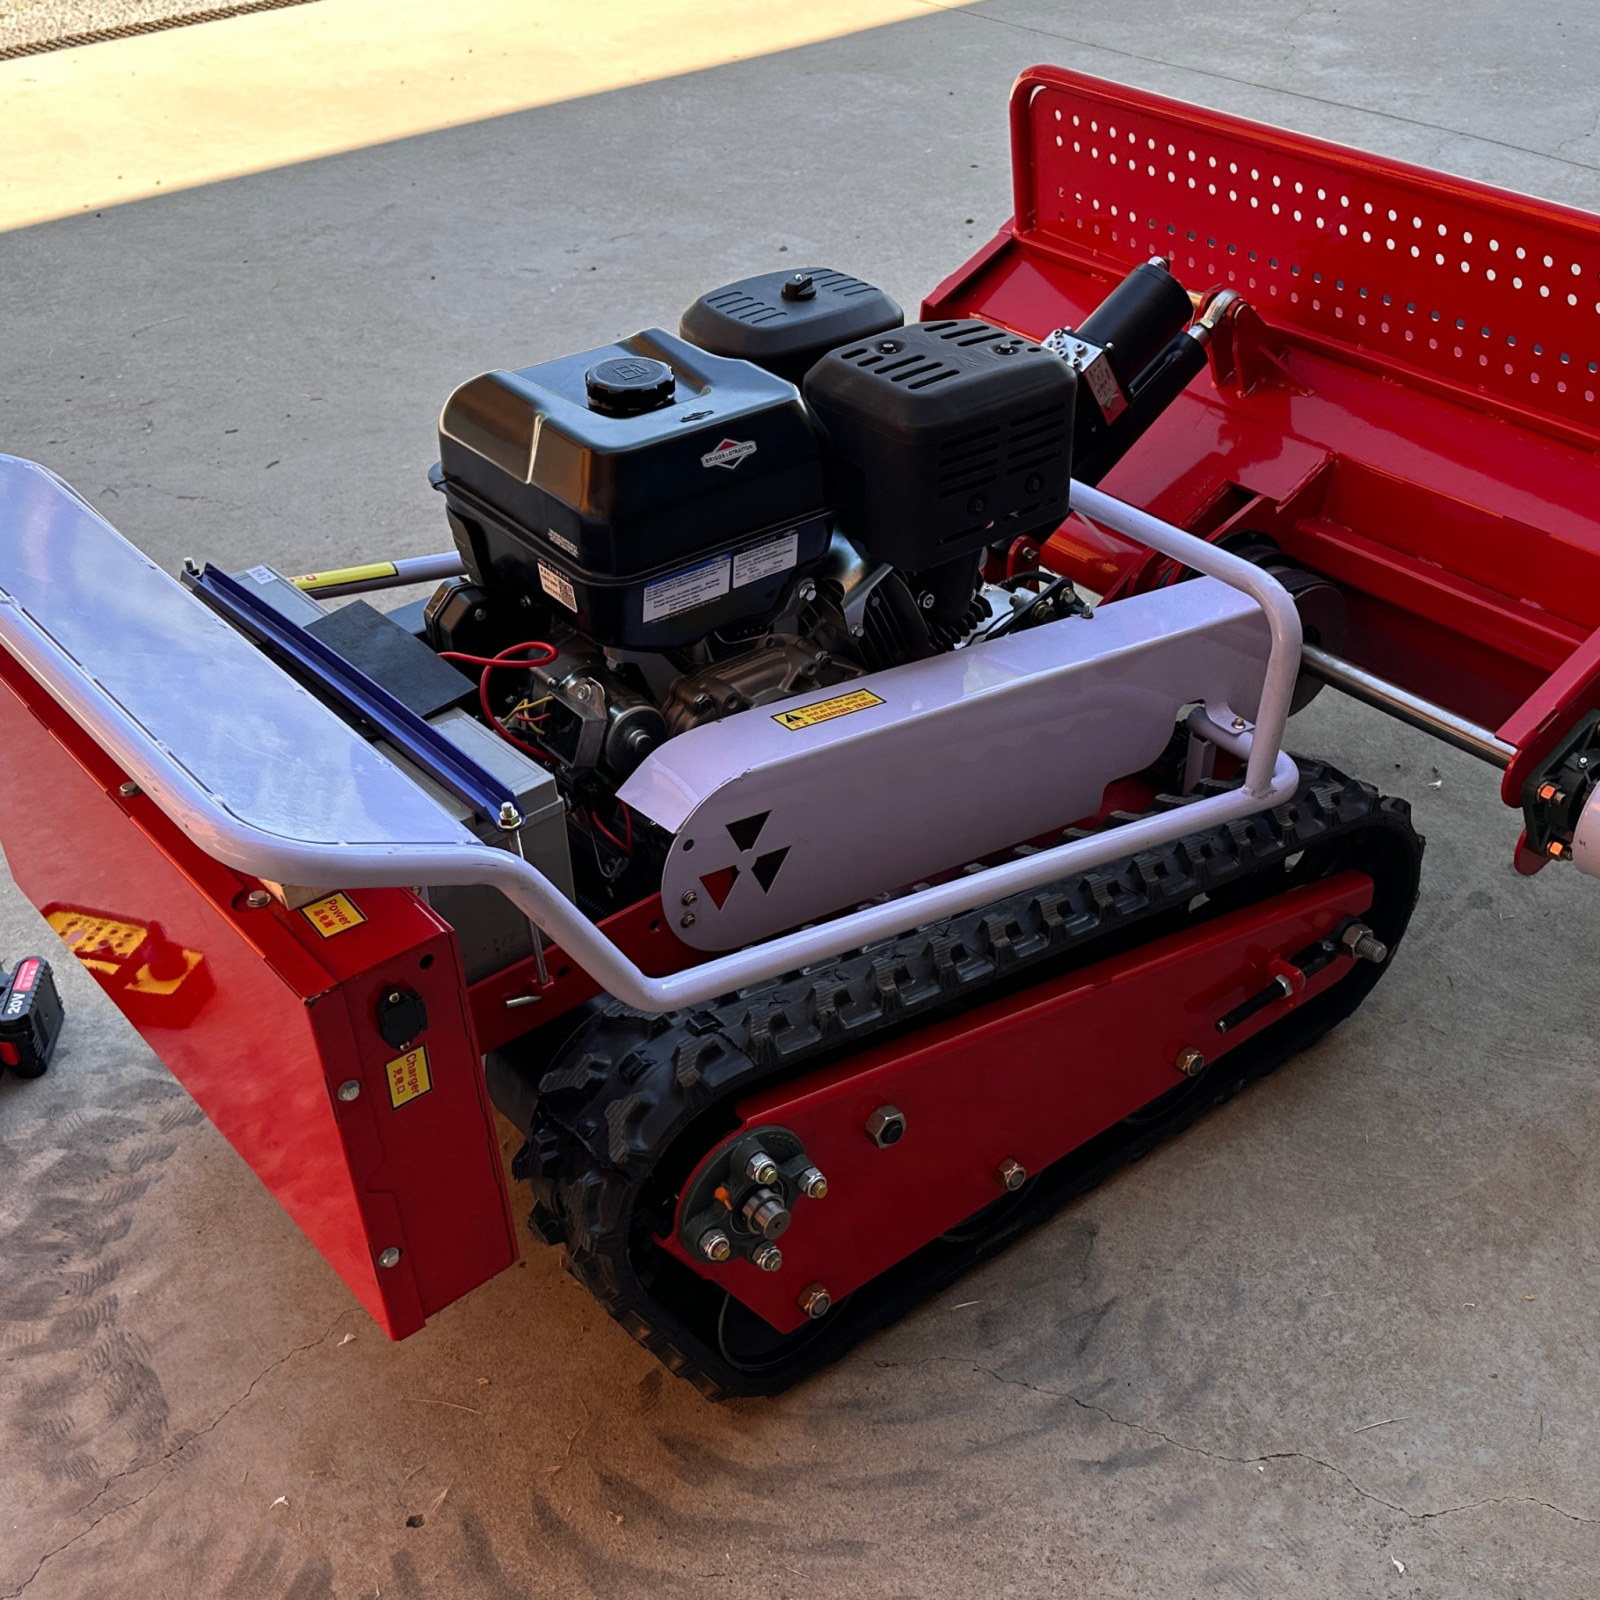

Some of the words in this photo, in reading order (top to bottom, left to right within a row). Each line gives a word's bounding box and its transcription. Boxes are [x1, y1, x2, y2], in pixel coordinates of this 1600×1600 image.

[324, 898, 351, 926] Power
[7, 992, 26, 1015] 20V
[393, 1066, 406, 1095] 充电口
[405, 1052, 420, 1094] Charger
